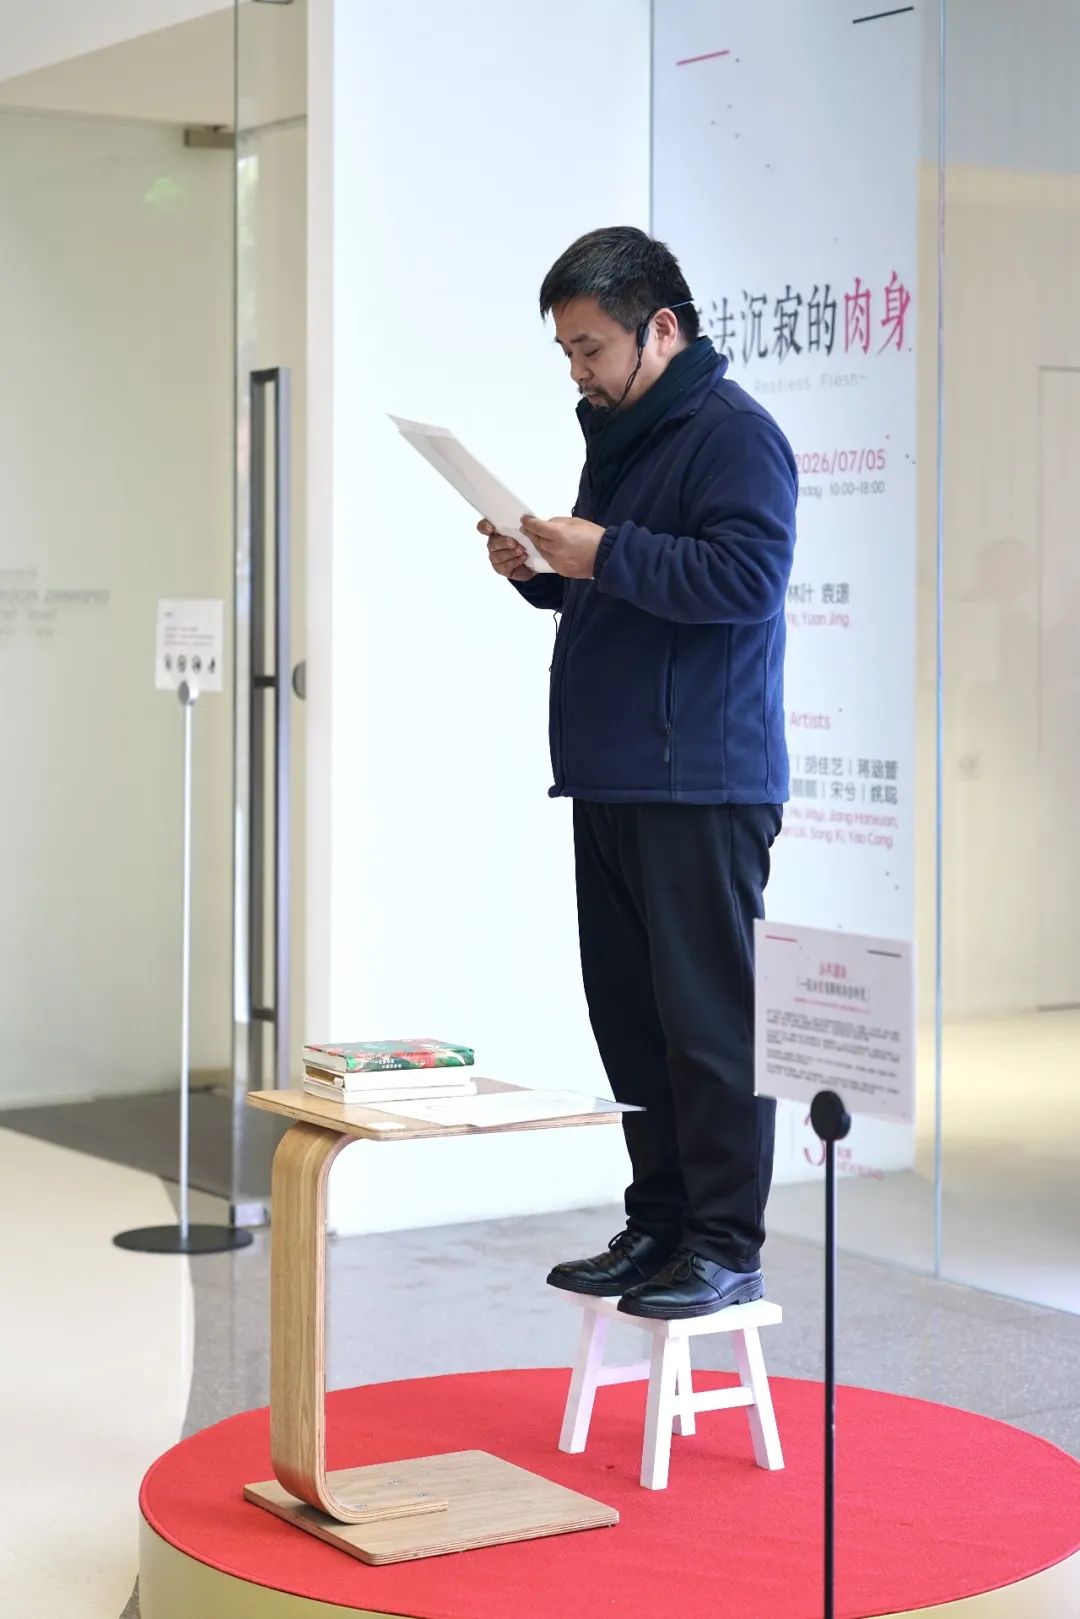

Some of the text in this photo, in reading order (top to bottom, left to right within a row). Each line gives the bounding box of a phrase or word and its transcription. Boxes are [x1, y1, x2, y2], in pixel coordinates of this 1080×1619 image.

[798, 480, 886, 499] nday 10:00-18:00
[790, 712, 831, 730] Artists
